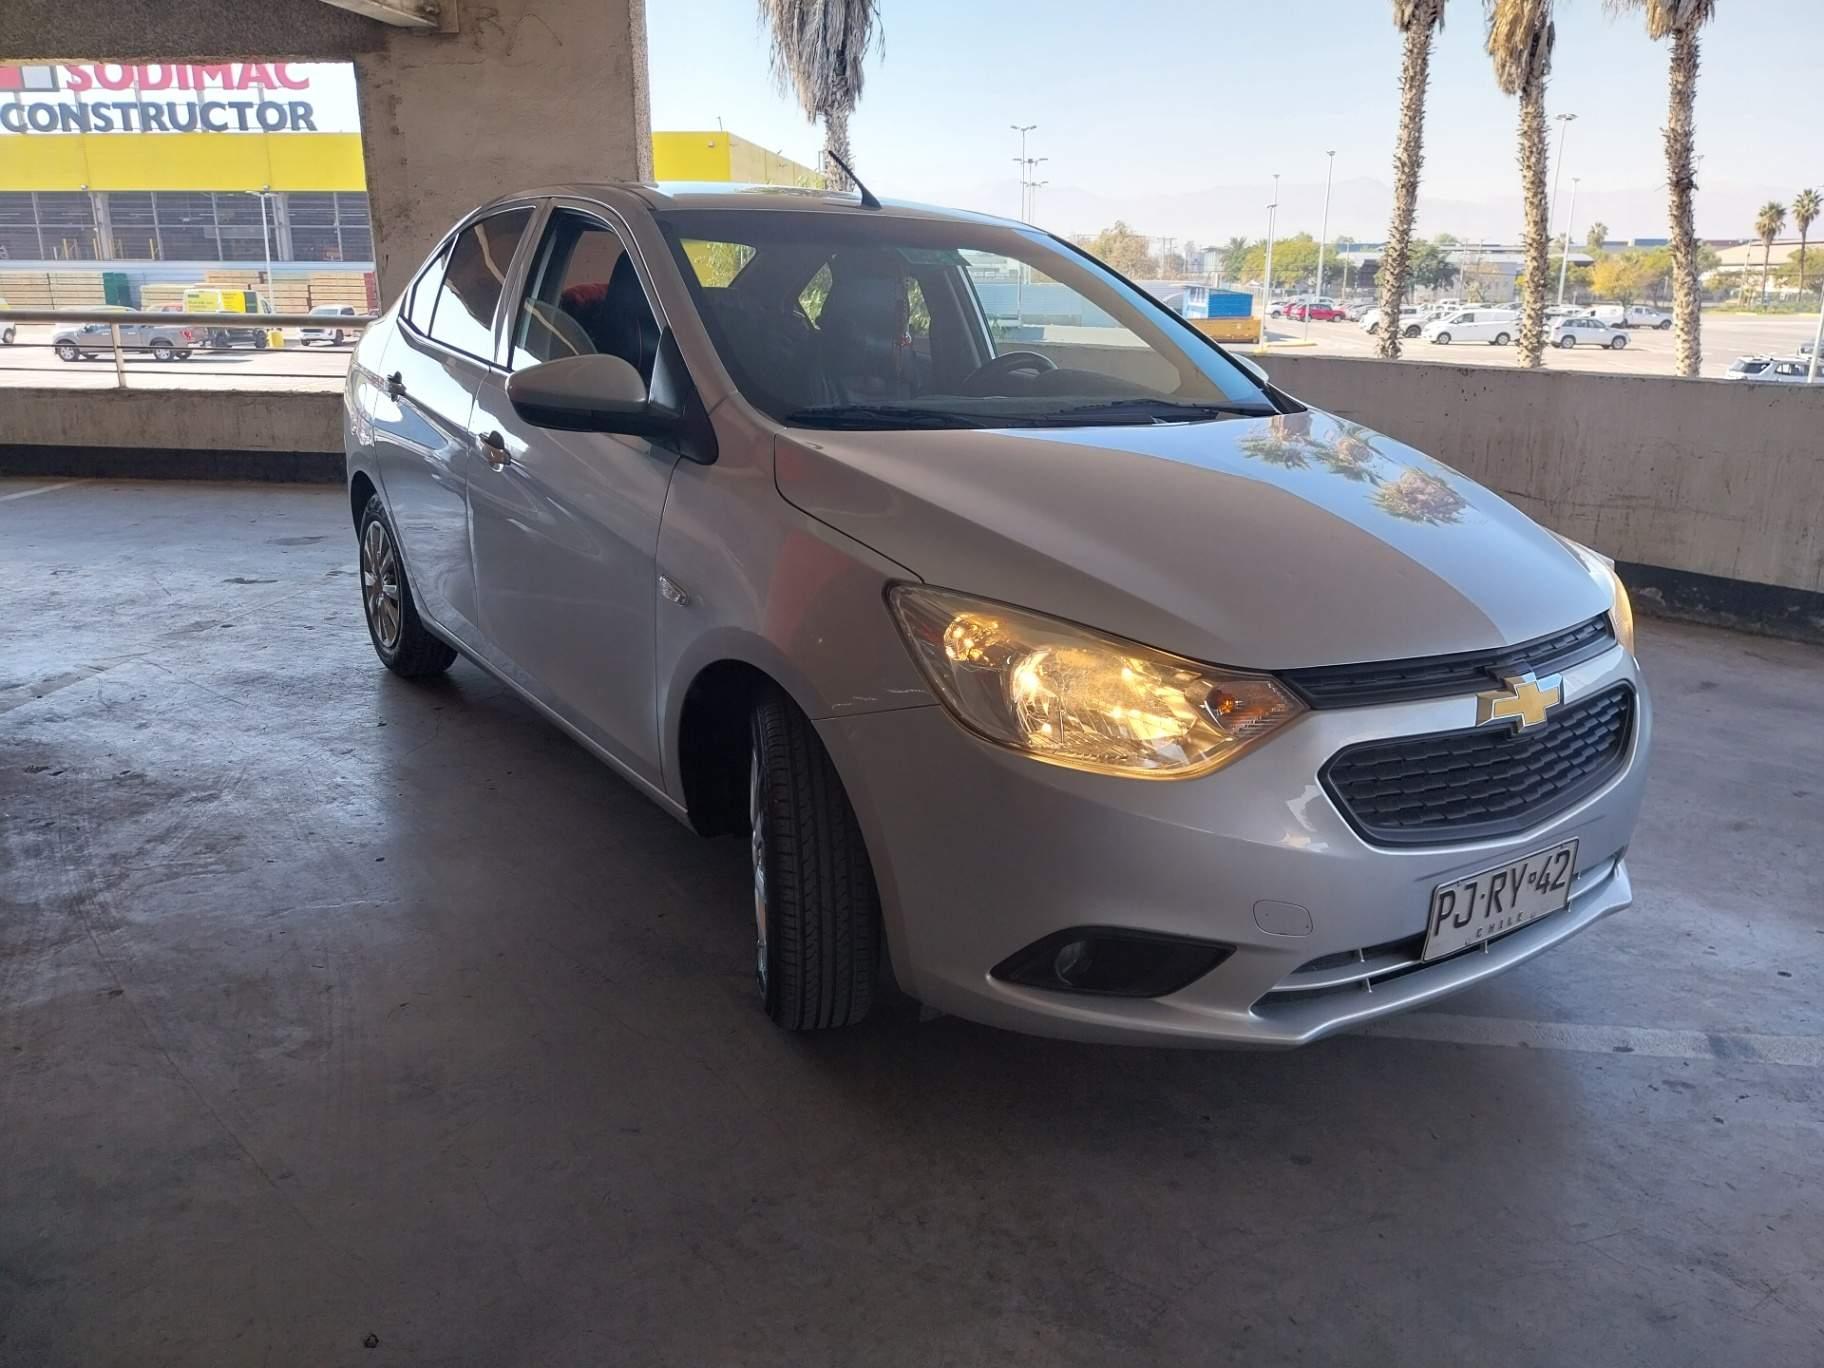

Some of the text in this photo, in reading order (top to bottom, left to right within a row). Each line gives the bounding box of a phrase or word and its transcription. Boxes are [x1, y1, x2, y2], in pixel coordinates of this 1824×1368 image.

[64, 63, 310, 91] SODIMAC
[0, 101, 318, 132] CONSTRUCTOR
[1475, 912, 1524, 938] CHILE
